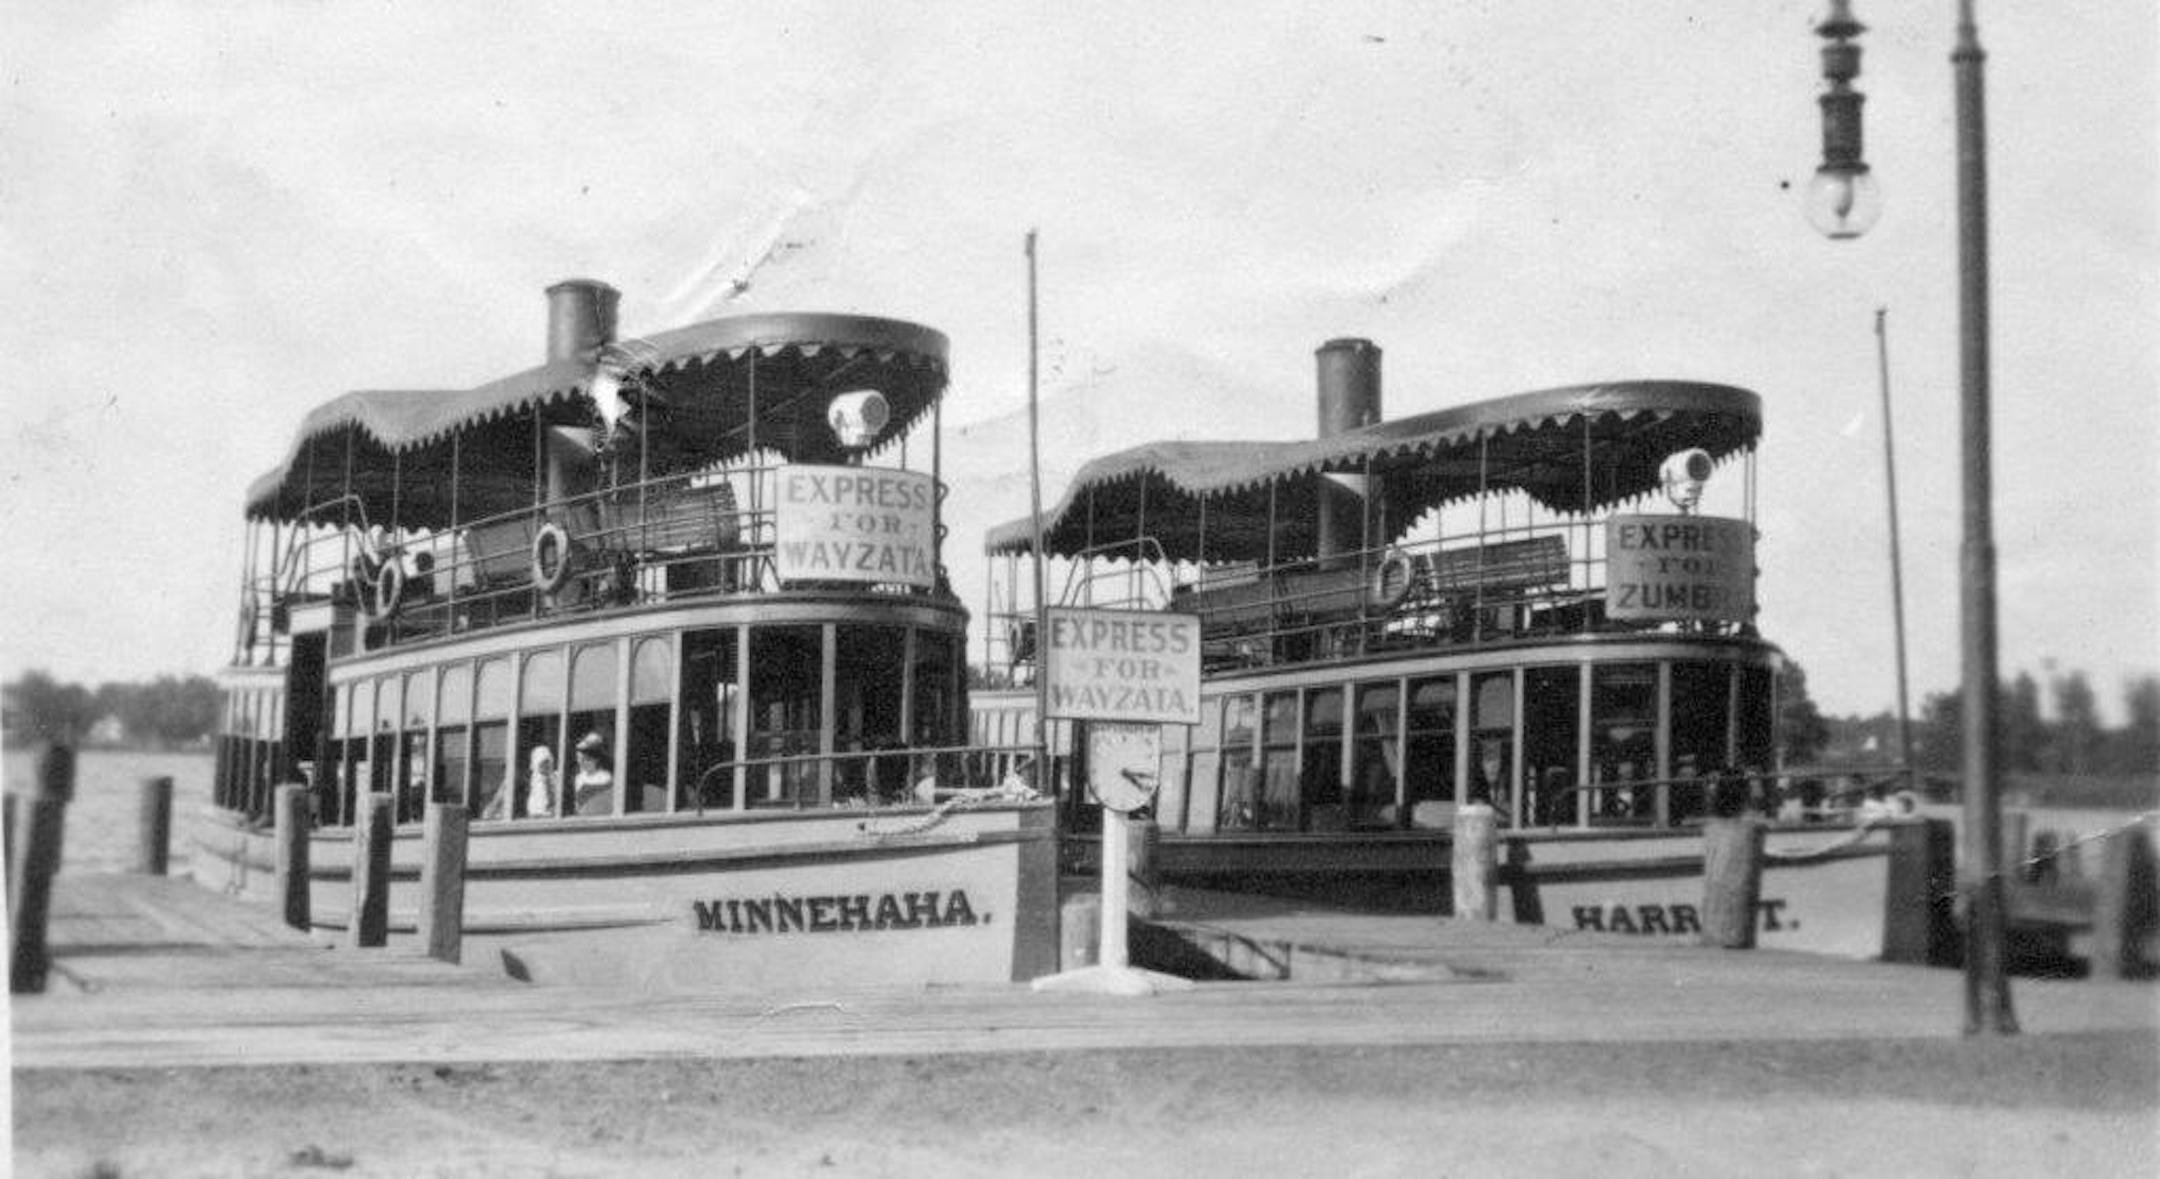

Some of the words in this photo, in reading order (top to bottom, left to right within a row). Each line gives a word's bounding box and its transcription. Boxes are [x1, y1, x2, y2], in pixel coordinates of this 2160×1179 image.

[787, 474, 927, 509] EXPRESS
[1620, 523, 1743, 555] EXPRES
[1617, 582, 1738, 612] ZUMB
[1052, 617, 1190, 653] EXPRESS
[693, 888, 993, 933] MINNEHAHA.
[1571, 898, 1800, 935] HARRT.
